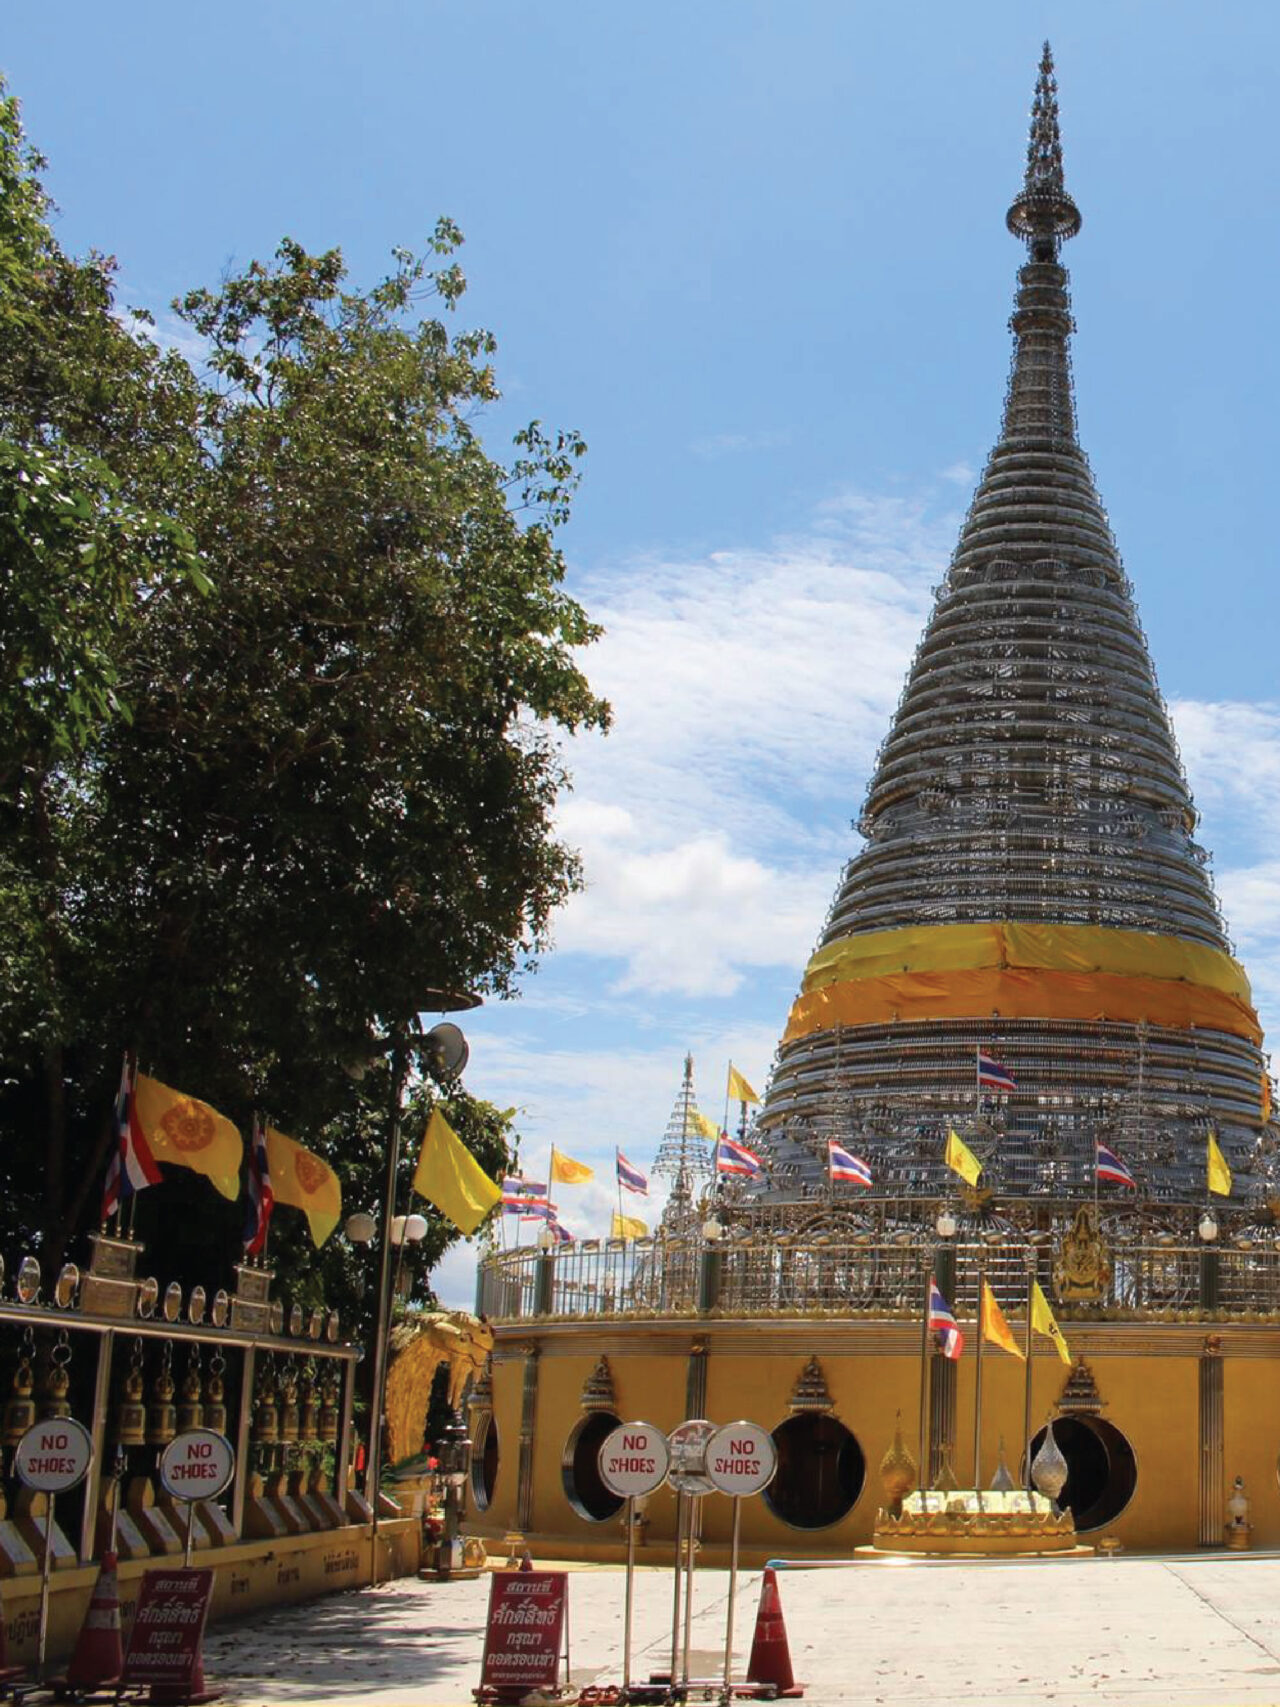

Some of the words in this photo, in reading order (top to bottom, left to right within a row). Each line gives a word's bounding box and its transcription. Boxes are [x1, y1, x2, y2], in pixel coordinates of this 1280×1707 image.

[41, 1434, 68, 1450] NO
[623, 1435, 647, 1450] NO
[729, 1439, 754, 1455] NO
[187, 1443, 212, 1459] NO
[28, 1457, 76, 1474] SHOES
[171, 1463, 218, 1480] SHOES
[609, 1457, 655, 1473] SHOES
[714, 1457, 760, 1475] SHOES
[506, 1632, 542, 1650] กรุณา
[487, 1648, 555, 1667] ถอดรองเท้า
